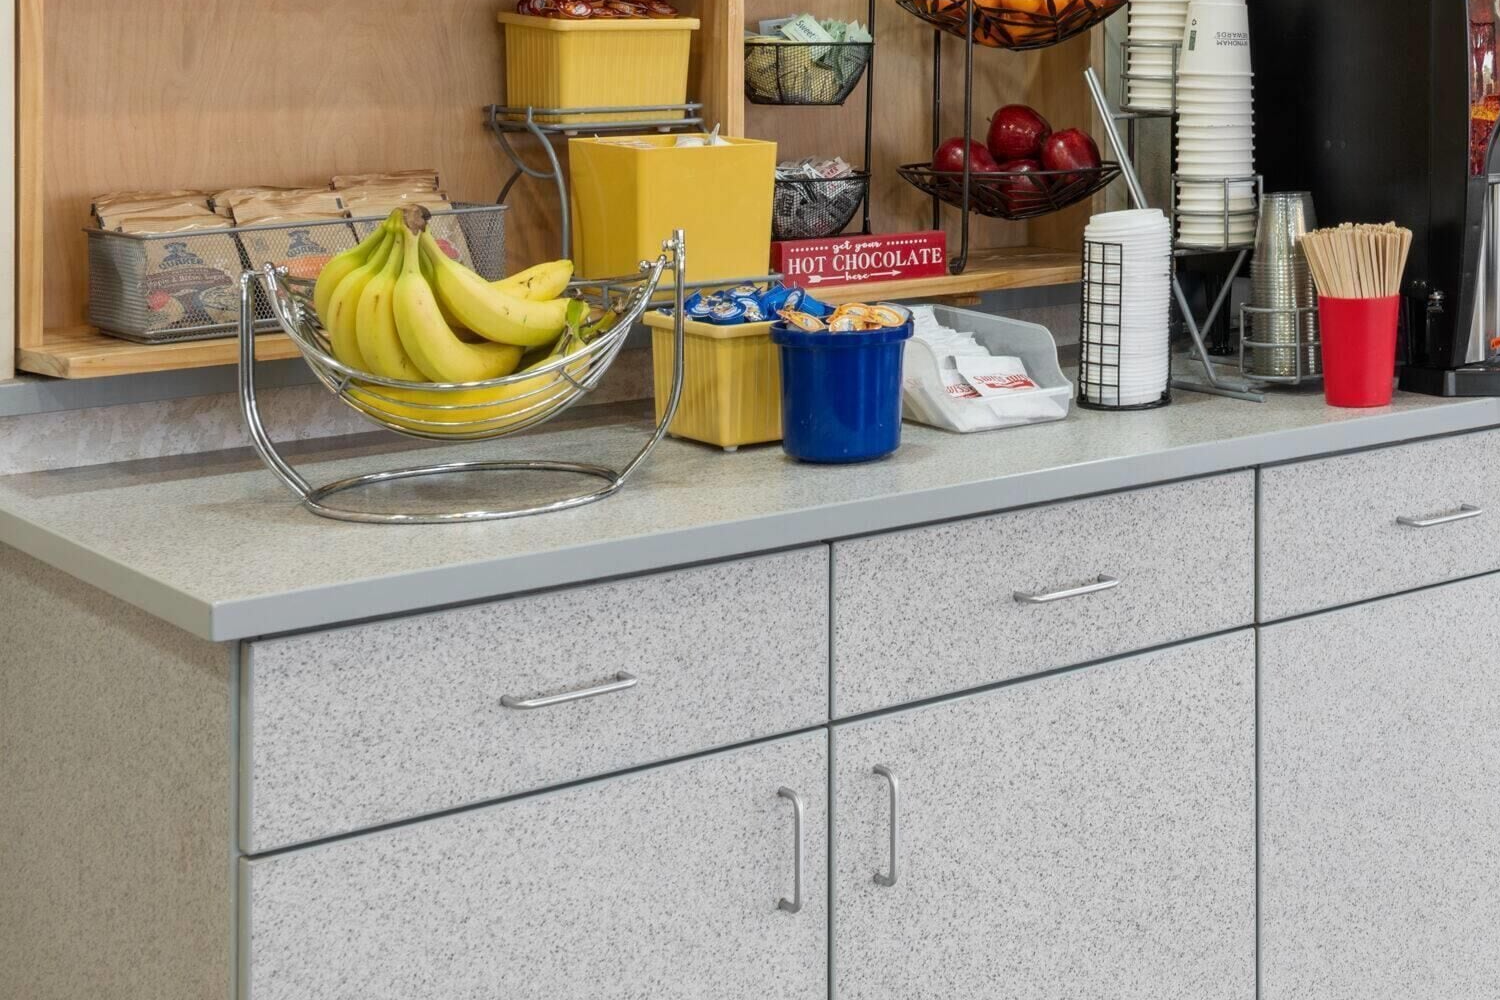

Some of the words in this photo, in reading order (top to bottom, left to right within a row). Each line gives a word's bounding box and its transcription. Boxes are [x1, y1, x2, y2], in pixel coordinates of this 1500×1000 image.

[795, 19, 816, 39] Sweet
[832, 240, 853, 254] get
[854, 240, 882, 253] your
[159, 257, 203, 270] QUAKER
[788, 256, 828, 275] HOT
[832, 247, 943, 272] CHOCOLATE
[844, 271, 871, 281] here
